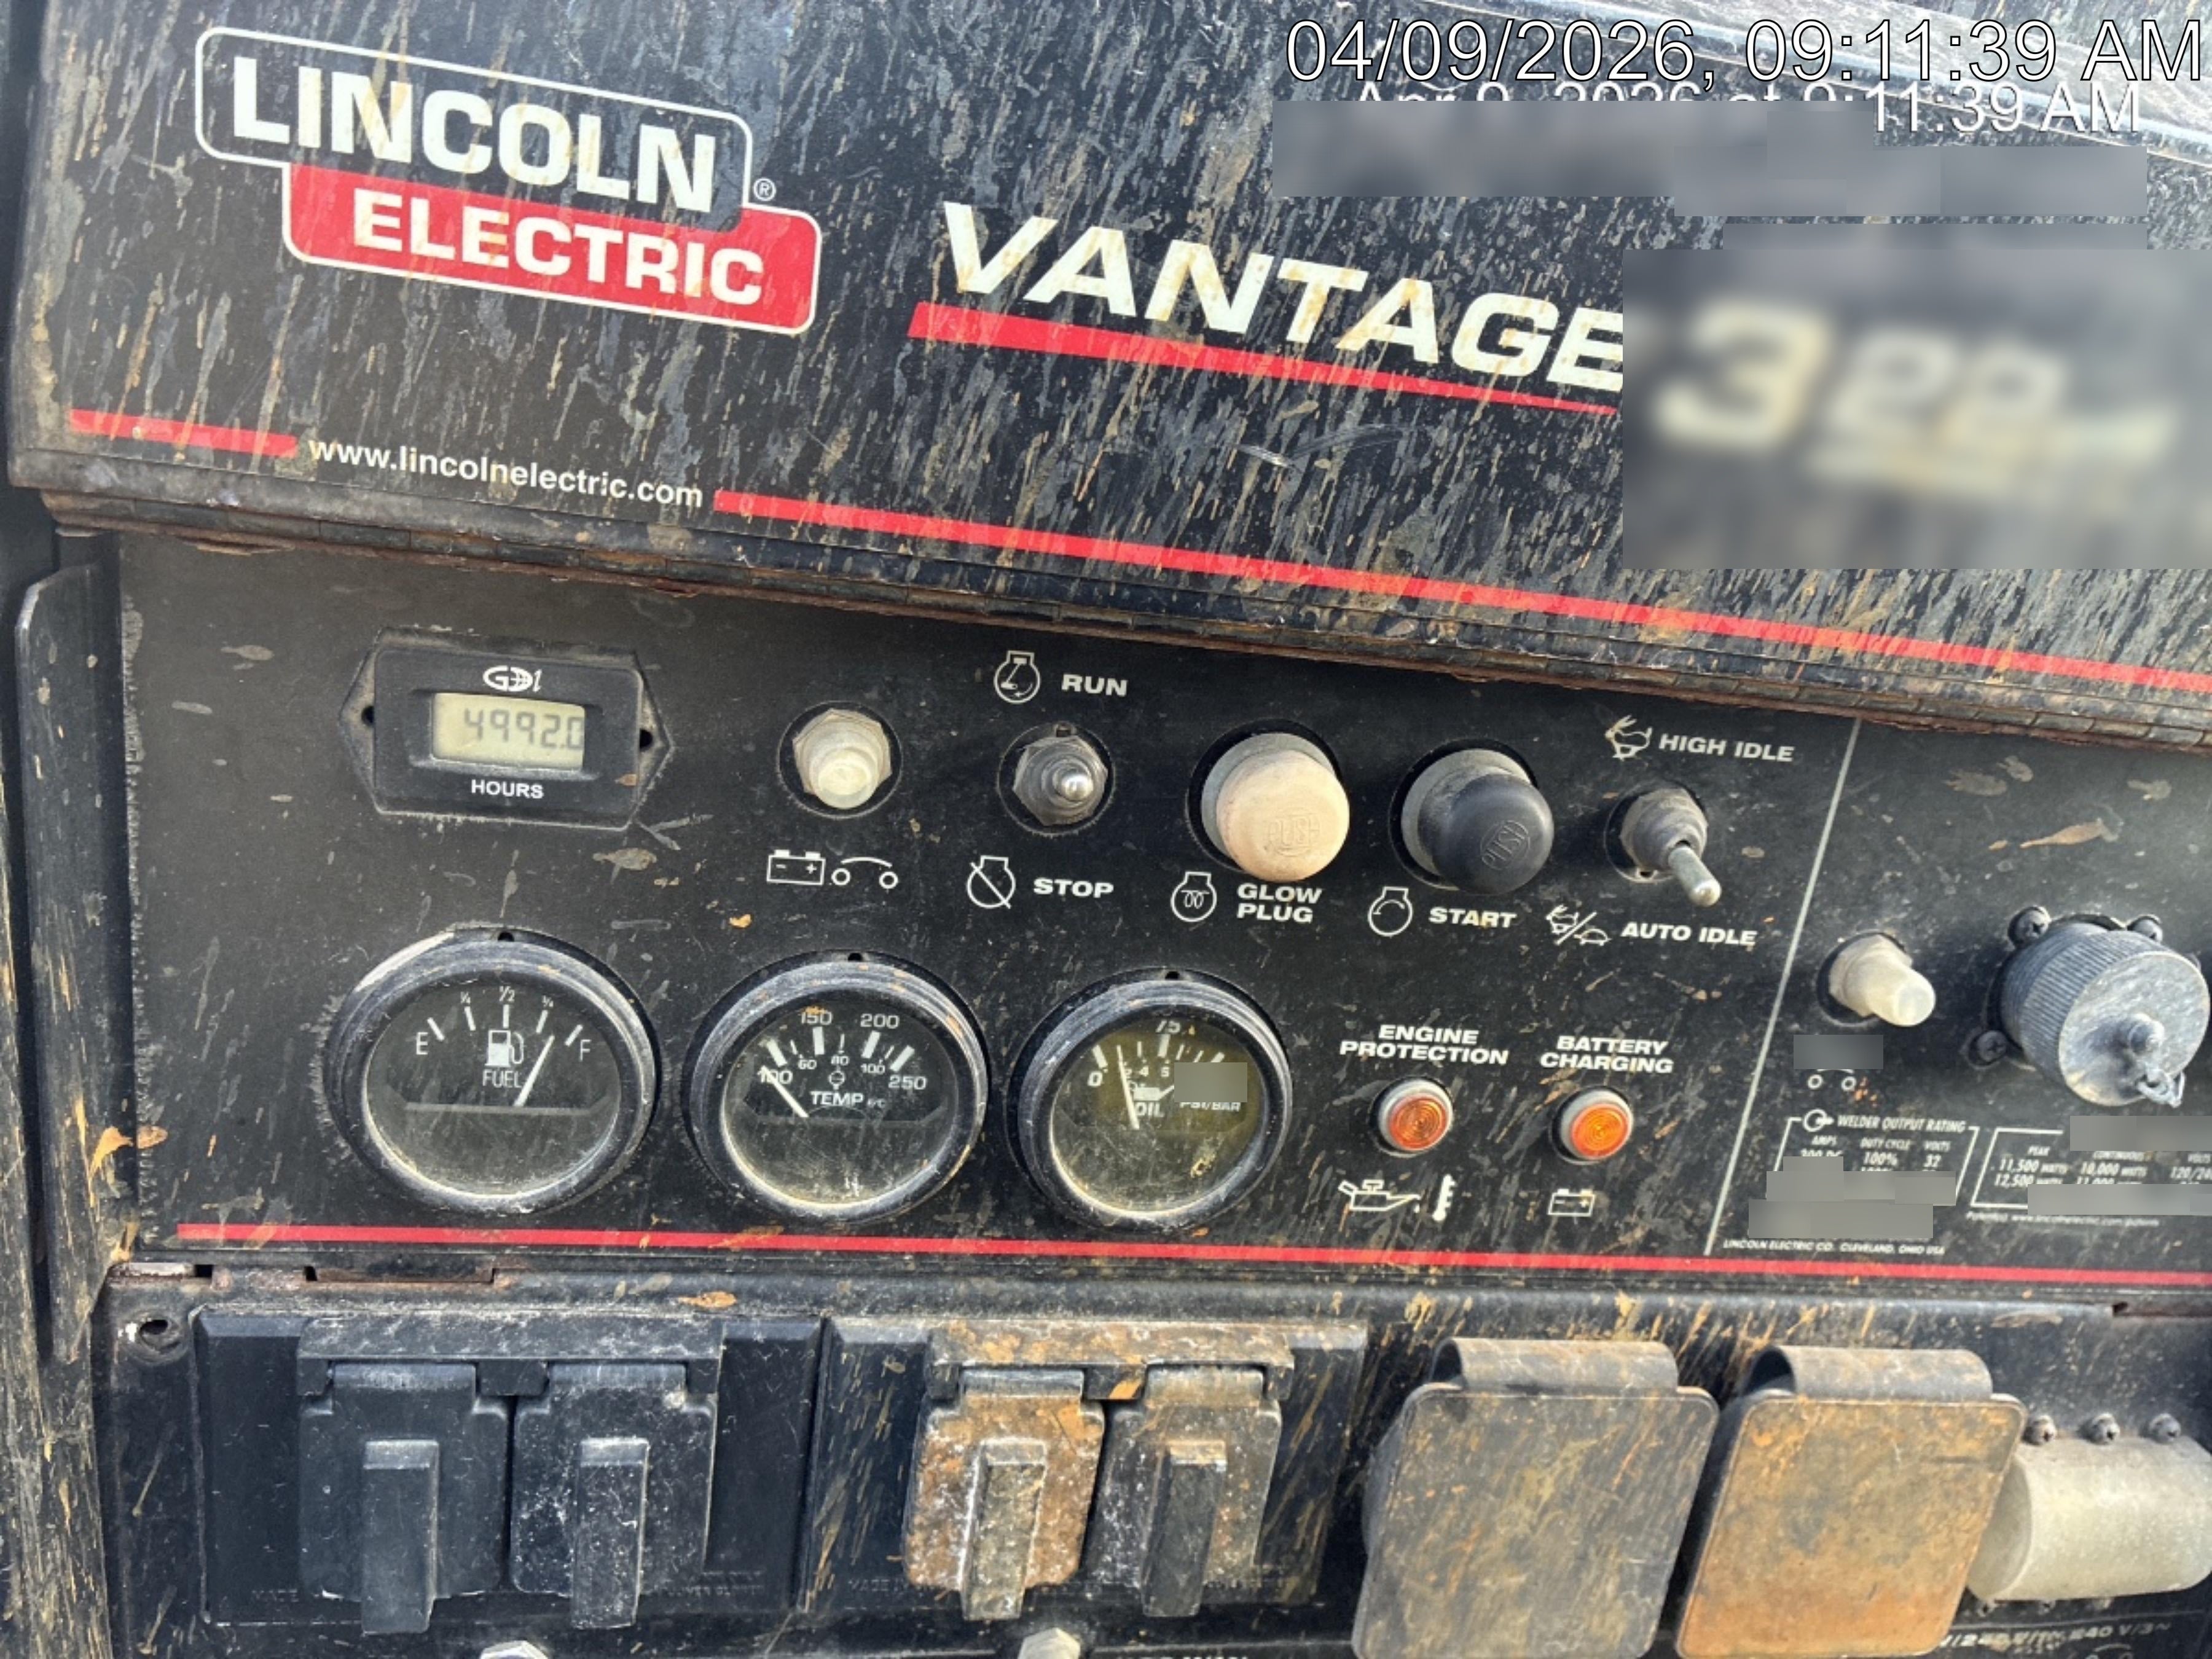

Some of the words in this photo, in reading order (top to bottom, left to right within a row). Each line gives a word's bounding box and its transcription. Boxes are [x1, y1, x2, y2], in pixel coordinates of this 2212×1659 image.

[233, 57, 716, 213] LINCOLN
[353, 188, 765, 305] ELECTRIC
[943, 200, 1623, 391] VANTAGE
[308, 437, 704, 508] www.lincolnelectric.com
[1061, 674, 1128, 697] RUN
[1658, 733, 1727, 756] HIGH
[1734, 740, 1795, 762] IDLE
[471, 779, 544, 799] HOURS
[1033, 878, 1114, 898] STOP
[1236, 884, 1322, 904] GLOW
[1236, 901, 1314, 924] PLUG
[1428, 907, 1517, 928] START
[1620, 922, 1692, 941] AUTO
[1698, 926, 1759, 946] IDLE
[860, 1013, 900, 1029] 200
[416, 1032, 429, 1056] E
[1378, 1024, 1480, 1045] ENGINE
[1556, 1035, 1668, 1055] BATTERY
[579, 1039, 591, 1062] F
[1339, 1041, 1509, 1065] PROTECTION
[1540, 1052, 1674, 1074] CHARGING
[482, 1070, 522, 1089] FUEL
[888, 1075, 927, 1091] 250
[1087, 1070, 1103, 1087] 0
[810, 1090, 864, 1106] TEMP
[1837, 1115, 1880, 1128] WELDER
[1882, 1117, 1925, 1131] OUTPUT
[1926, 1119, 1966, 1133] RATING
[1863, 1151, 1899, 1166] 100%
[1723, 1239, 1768, 1250] LINCOLN
[1770, 1241, 1813, 1251] ELECTRIC
